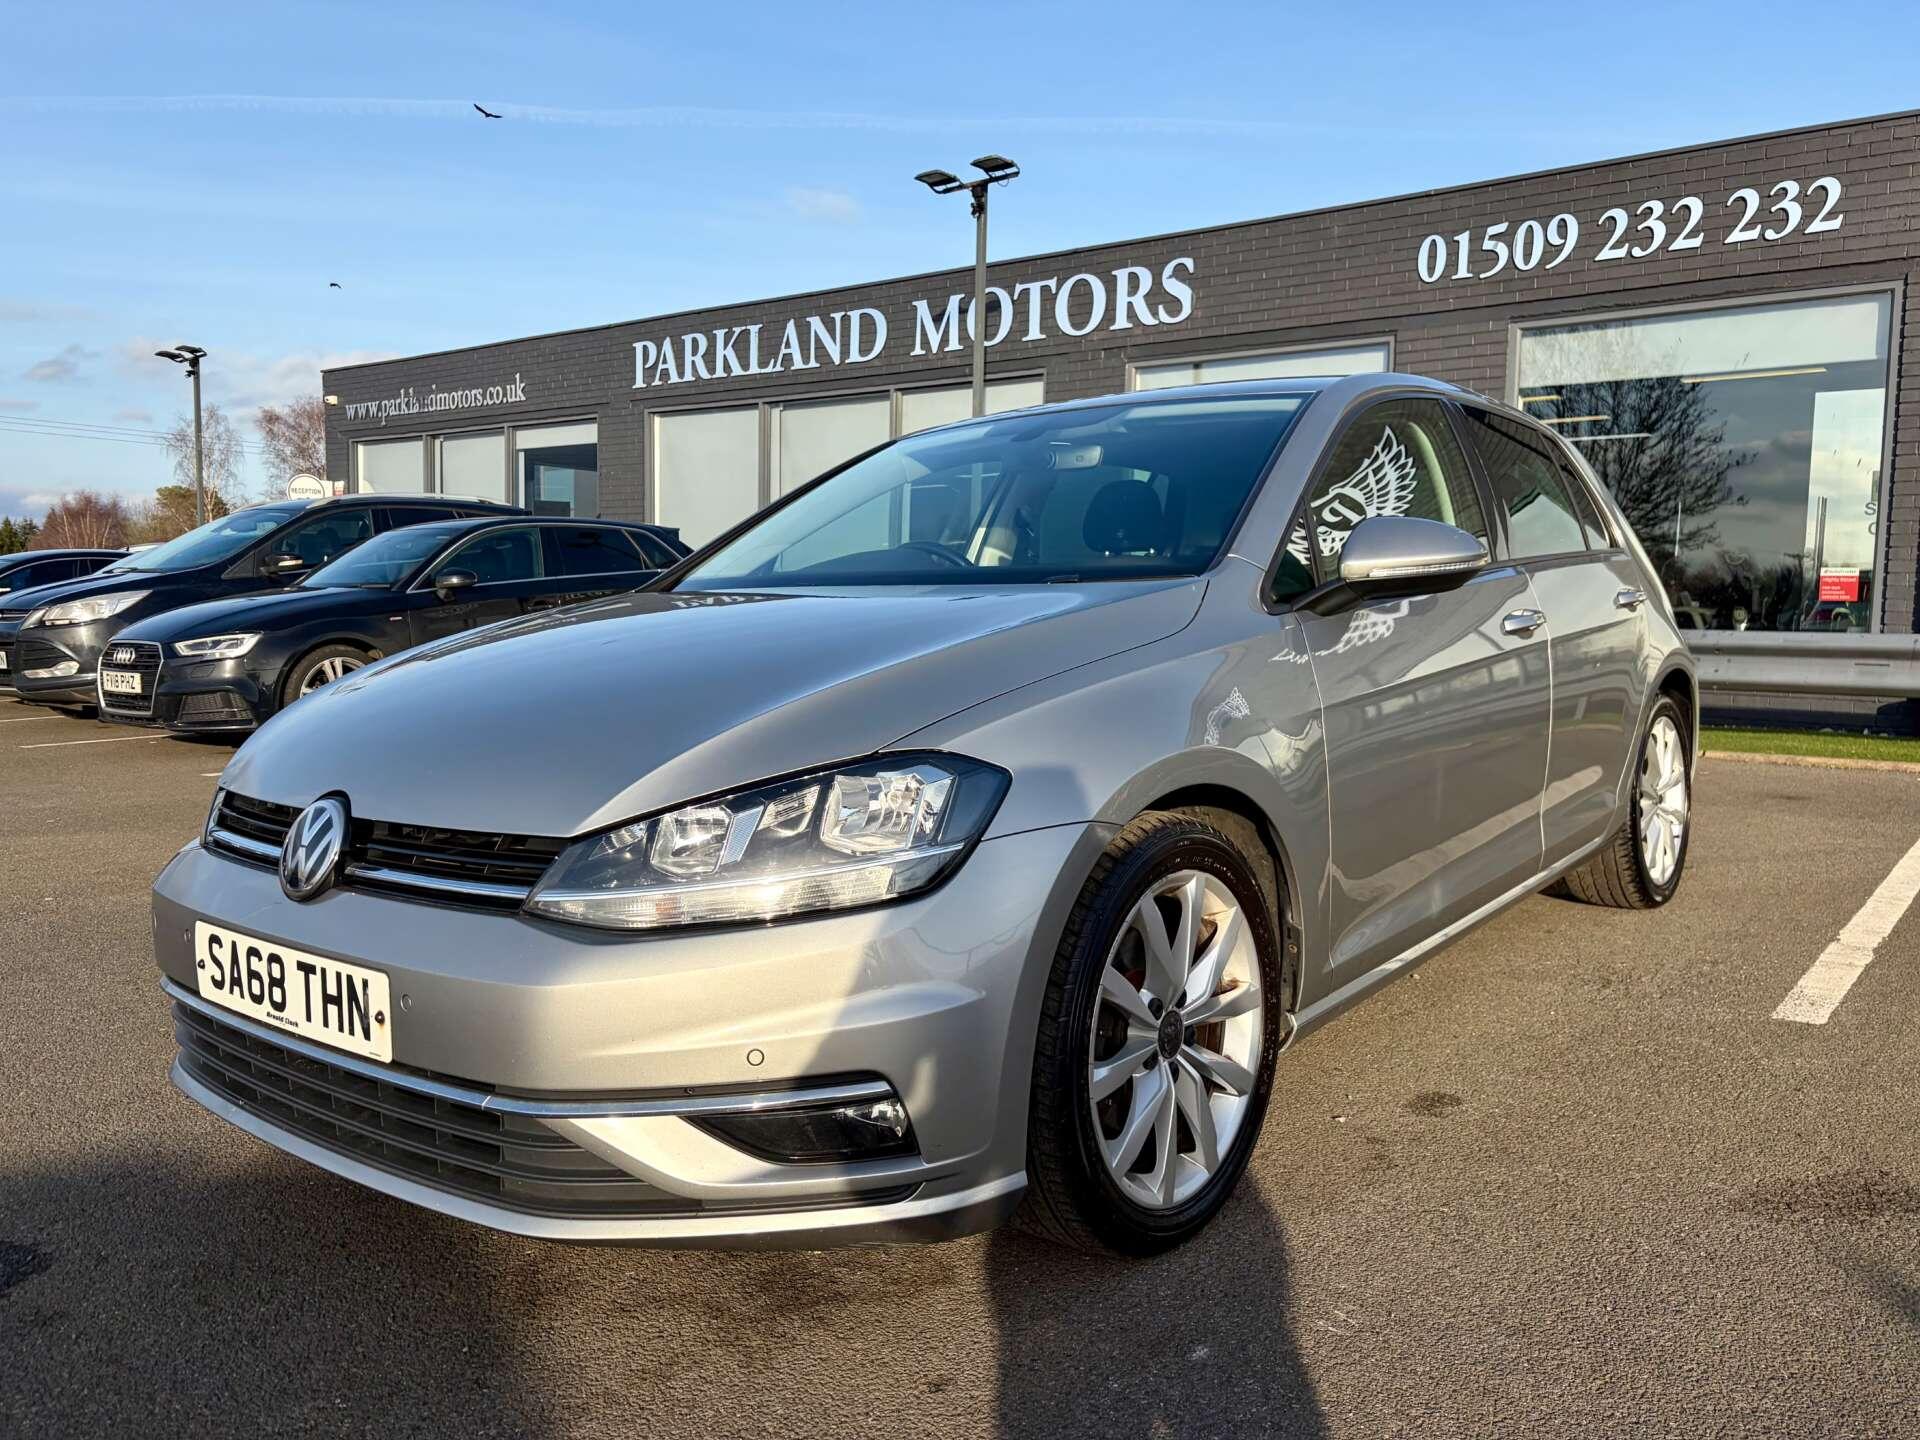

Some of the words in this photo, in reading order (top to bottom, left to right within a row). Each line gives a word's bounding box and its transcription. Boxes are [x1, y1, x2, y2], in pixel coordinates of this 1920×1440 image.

[1416, 212, 1580, 284] 01509
[1594, 195, 1706, 262] 232
[1723, 176, 1844, 245] 232
[631, 306, 888, 389] PARKLAND
[910, 257, 1196, 357] MOTORS
[290, 487, 322, 495] RECEPTION
[120, 674, 136, 690] PHZ
[208, 933, 287, 1013] SA68
[296, 960, 372, 1042] THN
